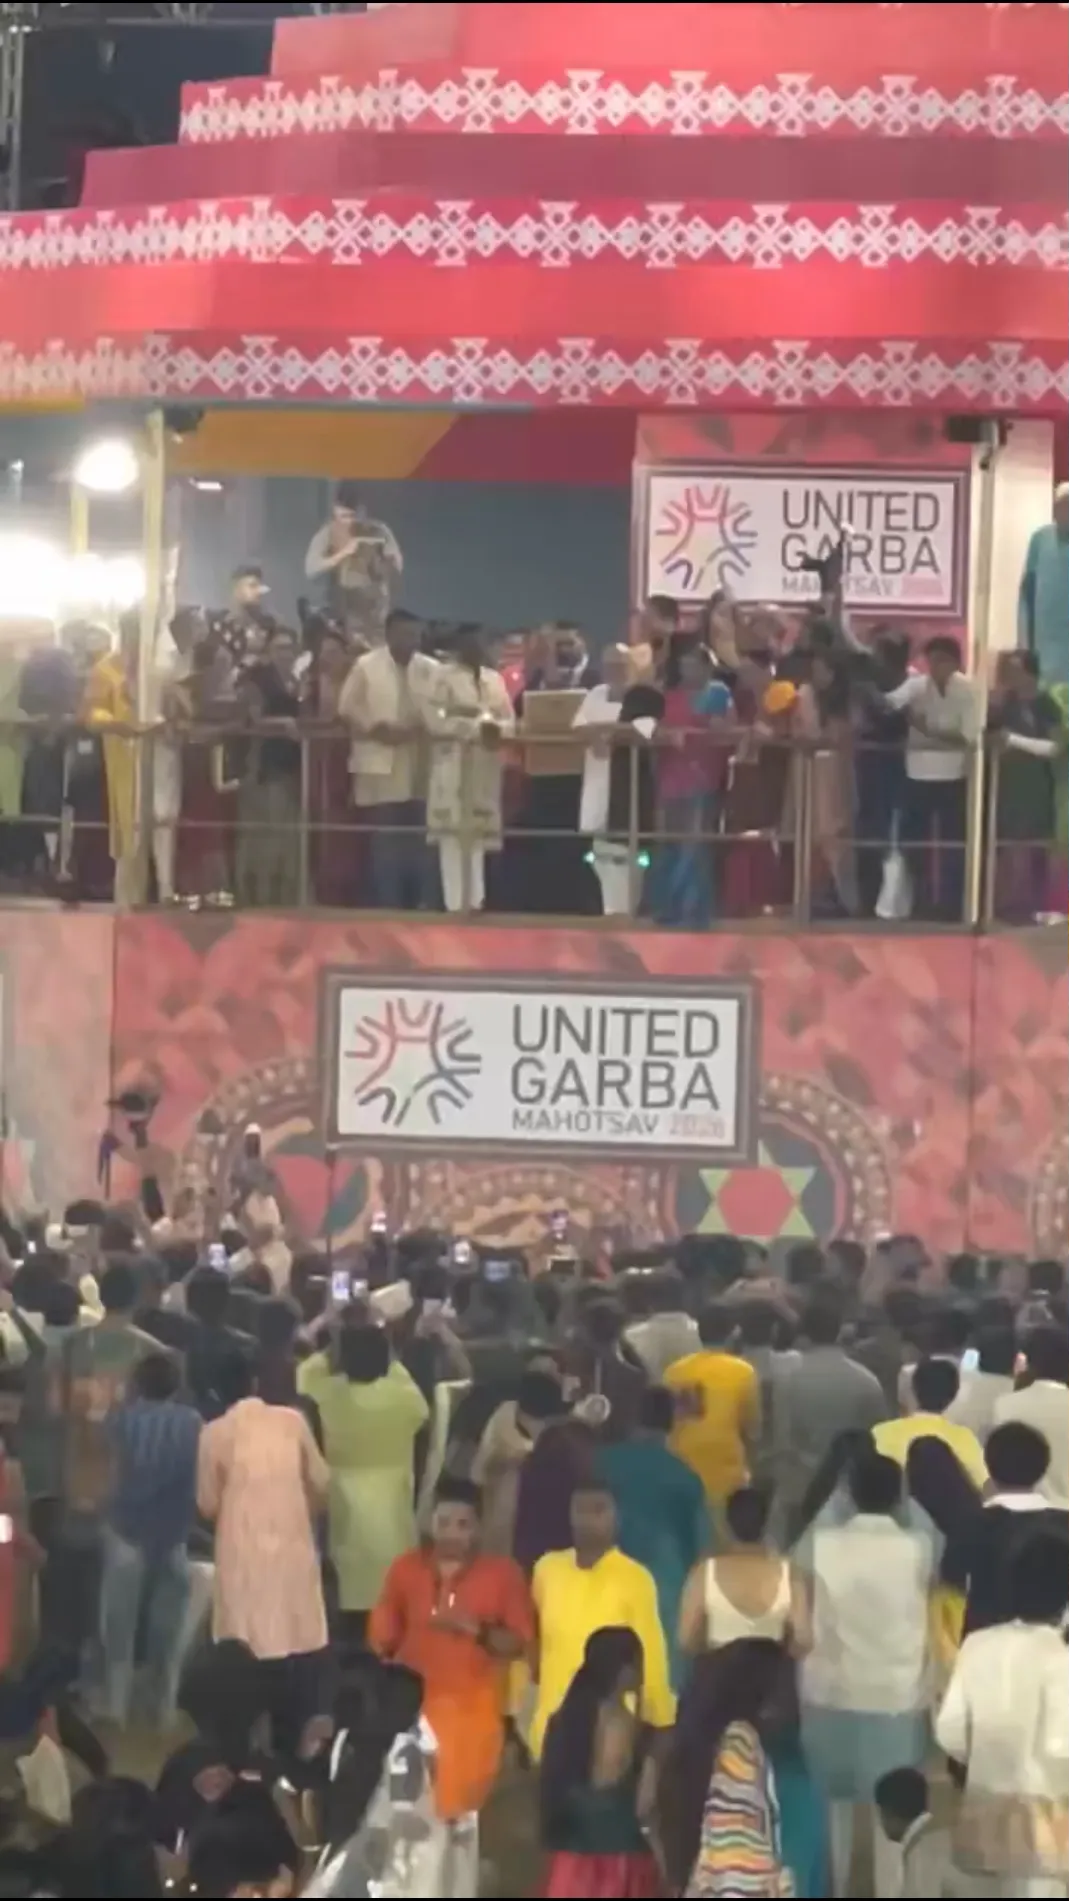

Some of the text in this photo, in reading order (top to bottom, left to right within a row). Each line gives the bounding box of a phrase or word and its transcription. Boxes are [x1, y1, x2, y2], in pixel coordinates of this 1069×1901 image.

[783, 489, 940, 532] UNITED
[781, 533, 940, 574] GARBA
[513, 1004, 720, 1058] UNITED
[511, 1056, 721, 1111] GARBA
[512, 1108, 659, 1136] MAHOTSAV
